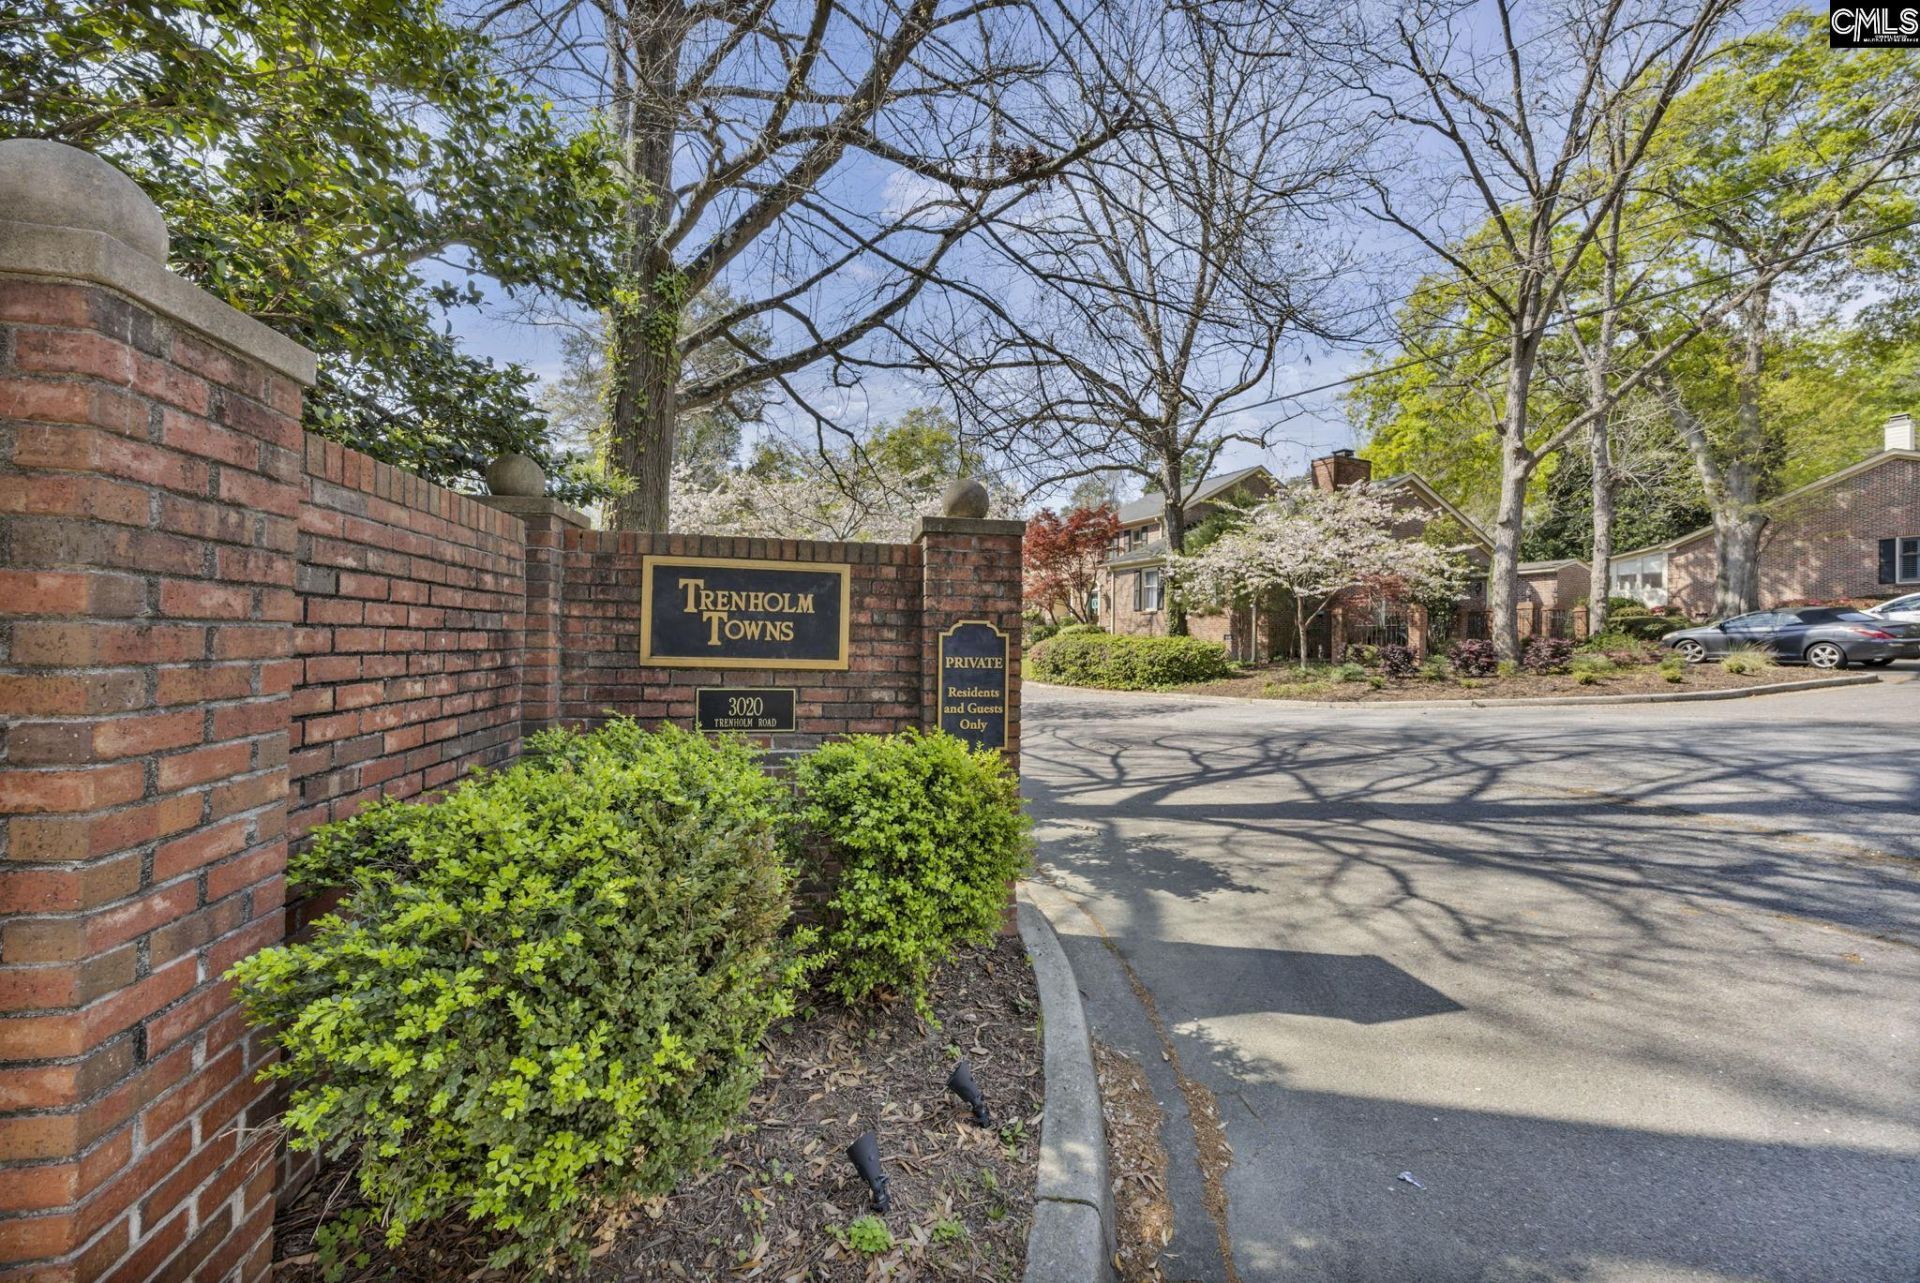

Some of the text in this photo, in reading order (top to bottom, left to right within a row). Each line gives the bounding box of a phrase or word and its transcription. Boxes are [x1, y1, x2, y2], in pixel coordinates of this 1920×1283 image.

[678, 578, 815, 614] TRENHOLM
[702, 611, 794, 646] TOWNS
[945, 656, 1003, 669] PRIVATE
[947, 687, 1000, 698] Residents
[728, 697, 763, 716] 3020
[943, 703, 1003, 714] and Guests
[714, 718, 777, 728] TRENHOLM ROAD
[959, 719, 988, 733] Only
